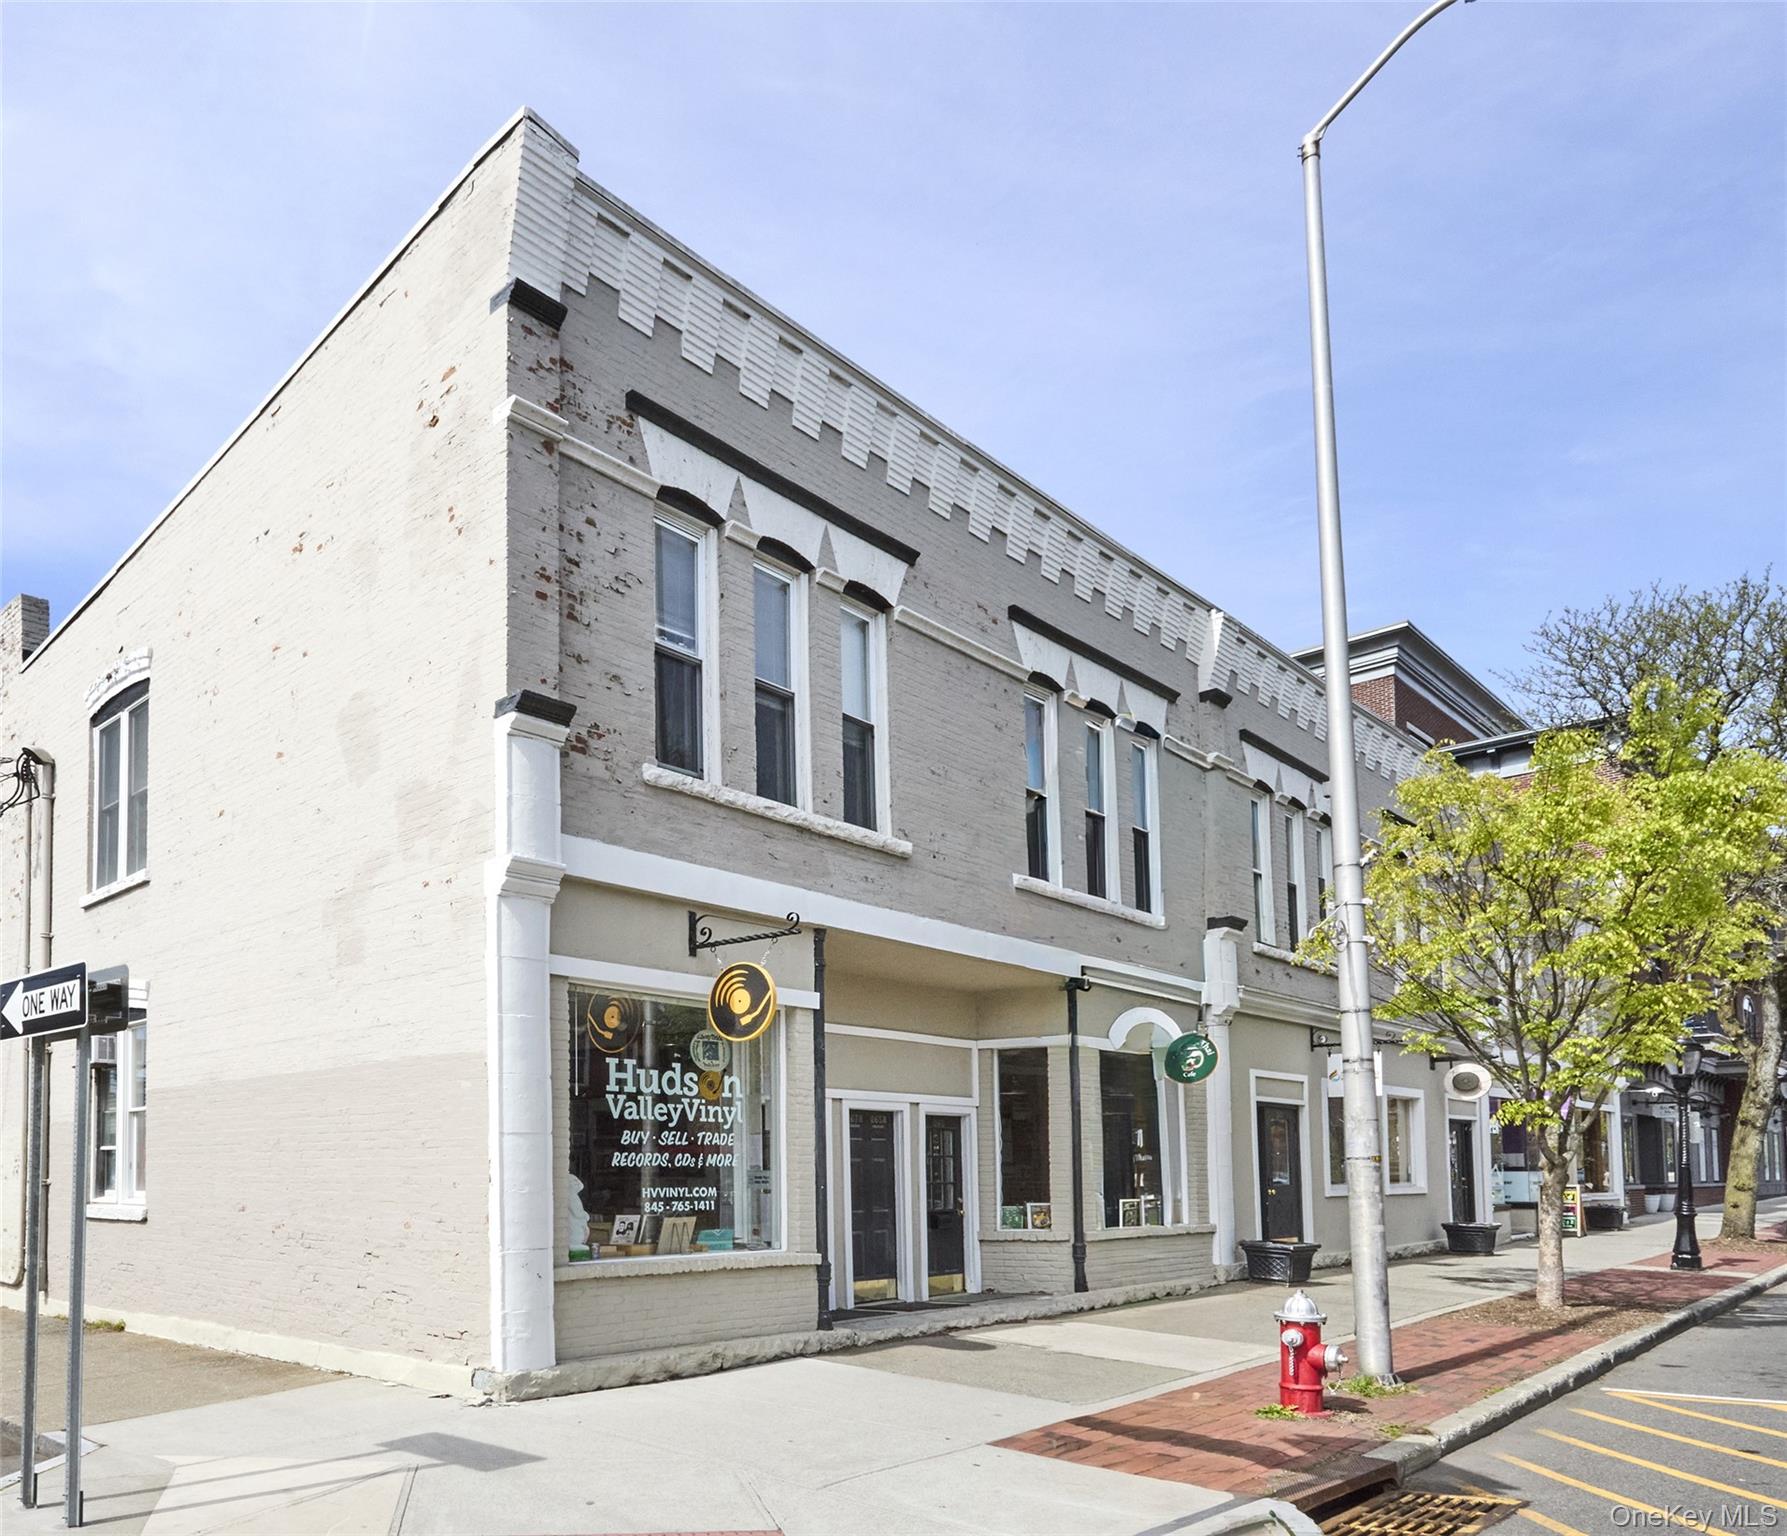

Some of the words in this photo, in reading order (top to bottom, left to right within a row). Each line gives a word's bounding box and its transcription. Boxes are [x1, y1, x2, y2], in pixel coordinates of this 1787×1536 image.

[22, 991, 45, 1017] ONE
[50, 983, 76, 1011] WAY
[620, 1130, 650, 1145] BUY
[658, 1130, 689, 1146] SELL
[697, 1131, 735, 1146] TRADE
[611, 1151, 672, 1168] RECORDS,
[674, 1152, 695, 1168] CDs
[705, 1153, 740, 1167] MORE
[642, 1187, 717, 1198] HVVINYL.COM
